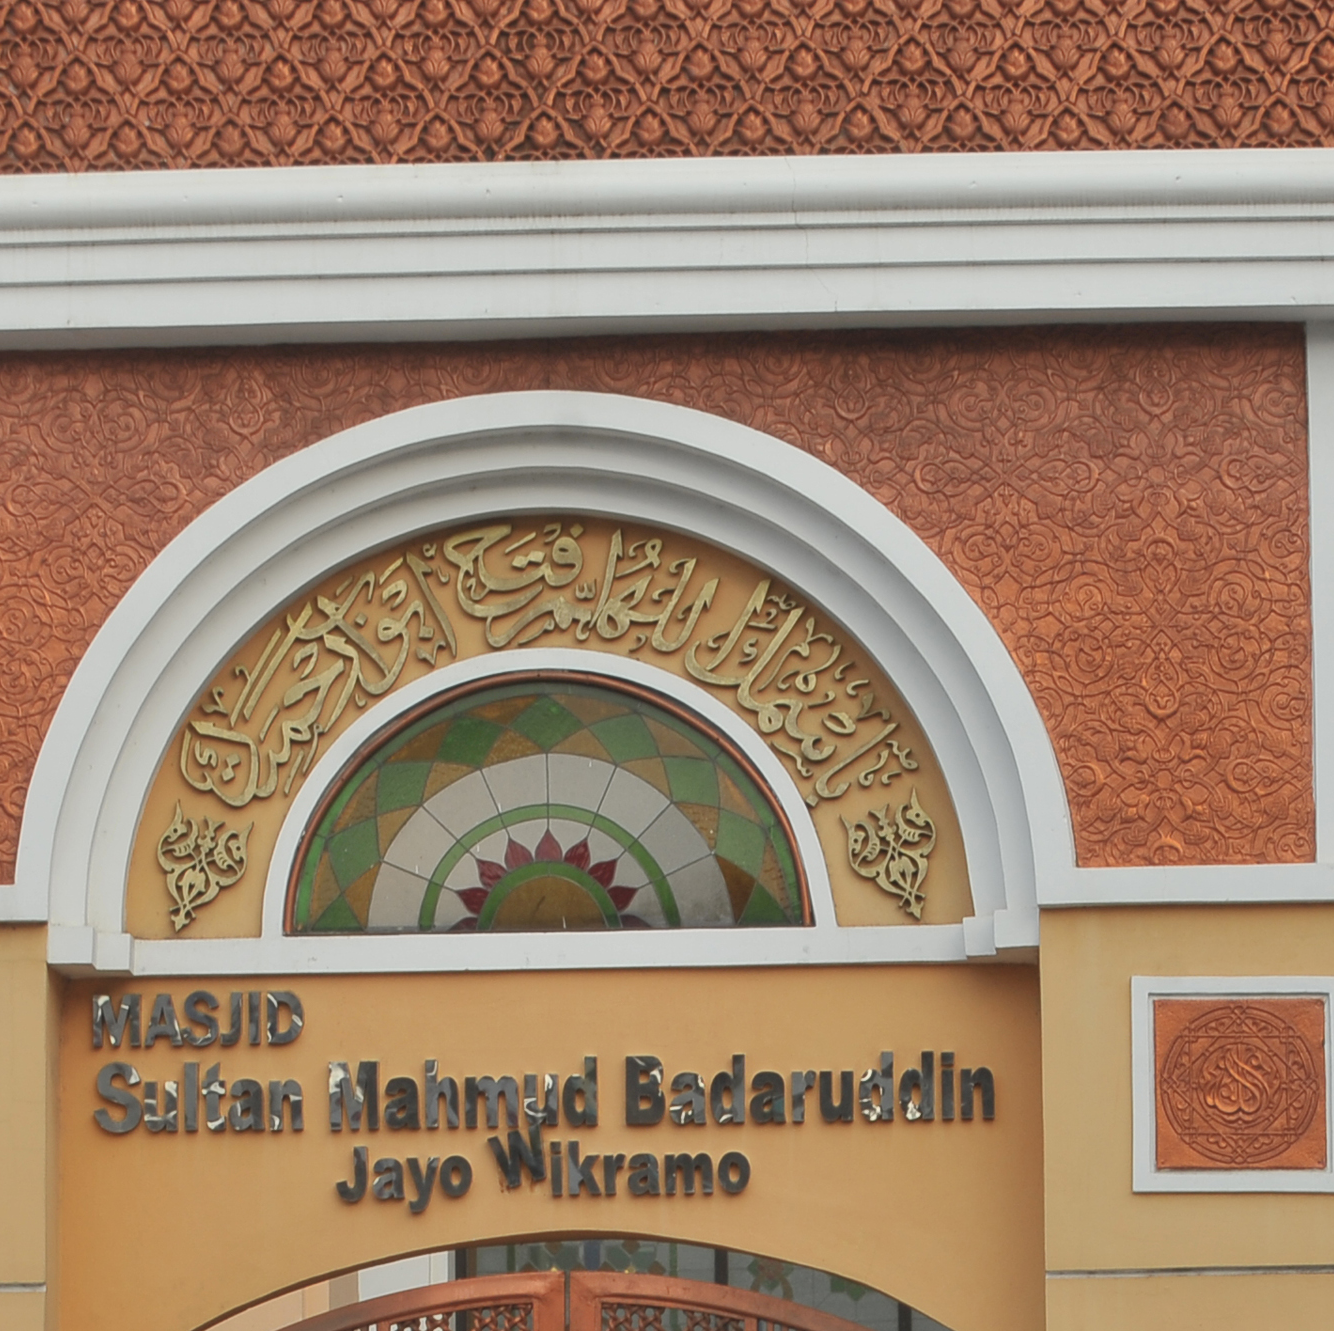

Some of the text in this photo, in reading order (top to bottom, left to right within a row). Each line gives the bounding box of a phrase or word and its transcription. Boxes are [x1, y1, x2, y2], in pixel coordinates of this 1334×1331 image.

[92, 990, 304, 1047] MASJID
[93, 1050, 995, 1133] Sultan Mahmud Badaruddin
[336, 1122, 750, 1213] Jayo Wikramo
